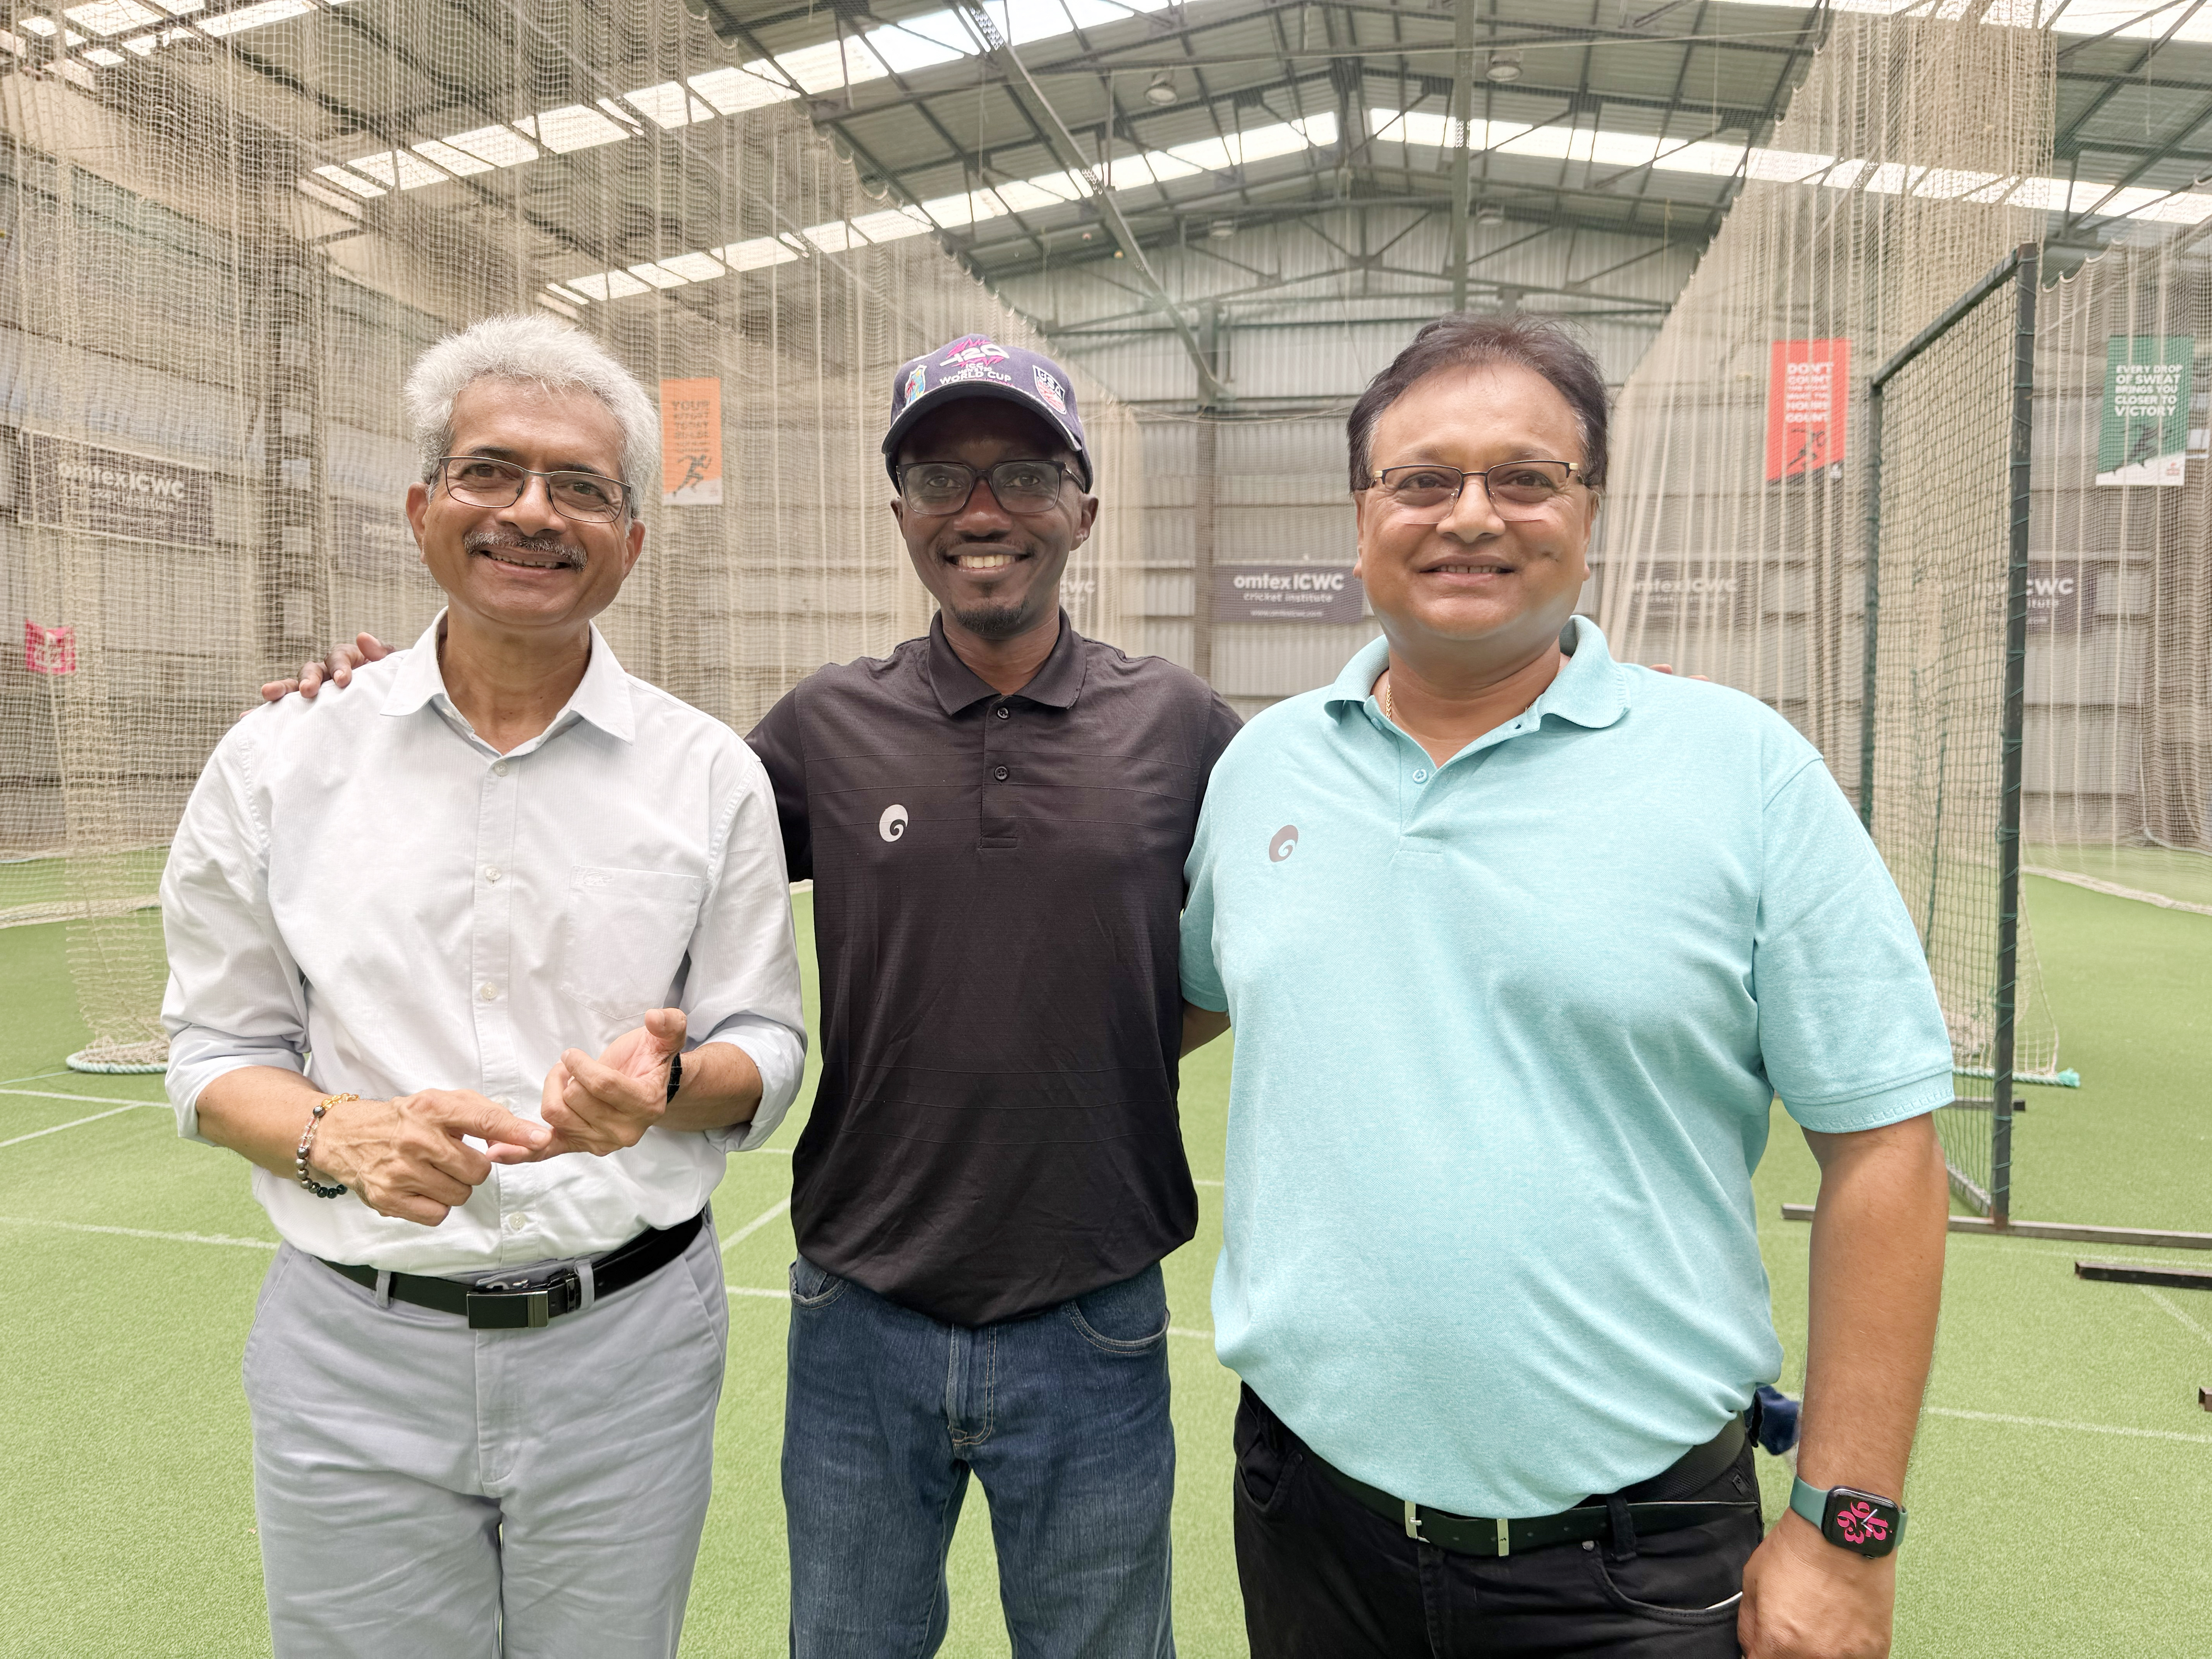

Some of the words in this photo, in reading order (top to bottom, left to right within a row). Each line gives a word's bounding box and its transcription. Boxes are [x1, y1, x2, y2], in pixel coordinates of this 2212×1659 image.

[2116, 364, 2151, 374] EVERY
[2153, 364, 2184, 373] DROP
[939, 371, 984, 385] WORLD
[987, 371, 1012, 382] CUP
[1037, 368, 1062, 399] USA
[2115, 374, 2134, 385] OF
[2135, 374, 2181, 385] SWEAT
[2115, 385, 2154, 394] BRINGS
[2156, 385, 2178, 394] YOU
[2114, 395, 2158, 405] CLOSER
[2162, 395, 2178, 405] TO
[2114, 405, 2176, 417] VICTORY
[1293, 573, 1345, 591] ICWC
[1243, 592, 1282, 602] cricket
[1285, 593, 1333, 603] institute
